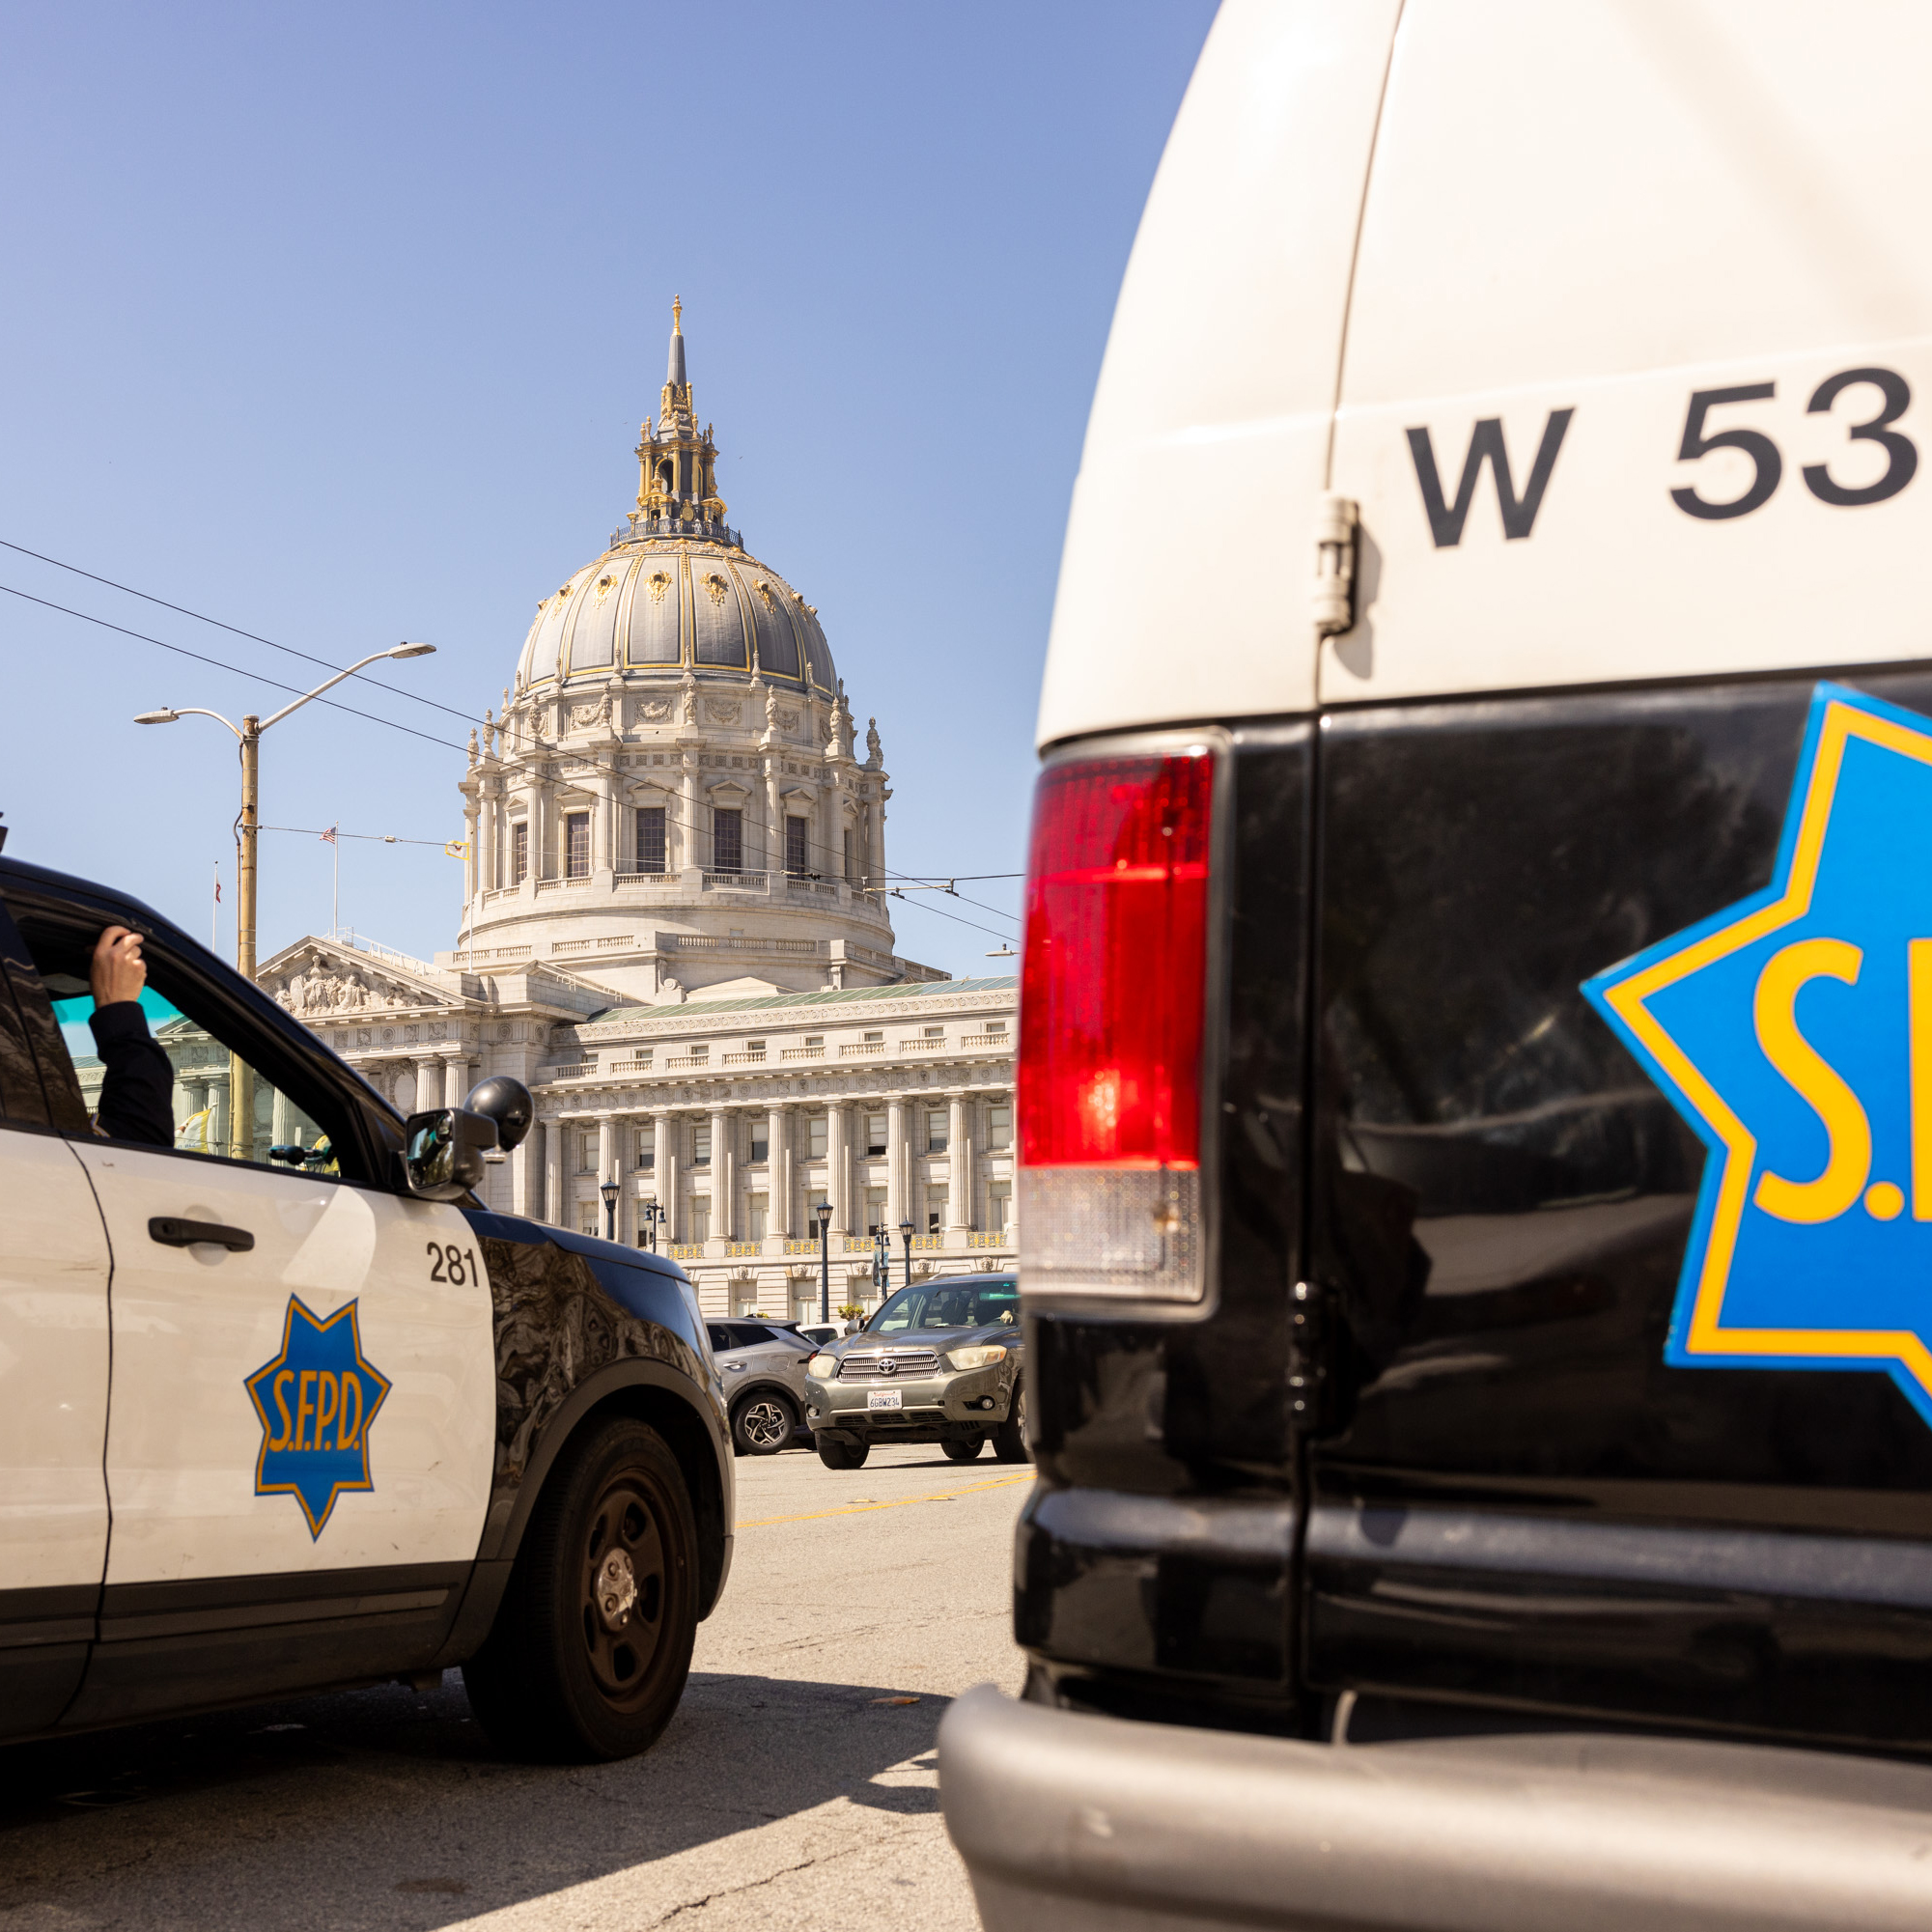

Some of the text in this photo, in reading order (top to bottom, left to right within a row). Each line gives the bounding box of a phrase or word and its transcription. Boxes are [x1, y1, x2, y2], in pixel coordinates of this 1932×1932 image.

[1405, 366, 1918, 549] W 53
[427, 1241, 479, 1287] 281
[268, 1369, 363, 1452] S.F.P.D.
